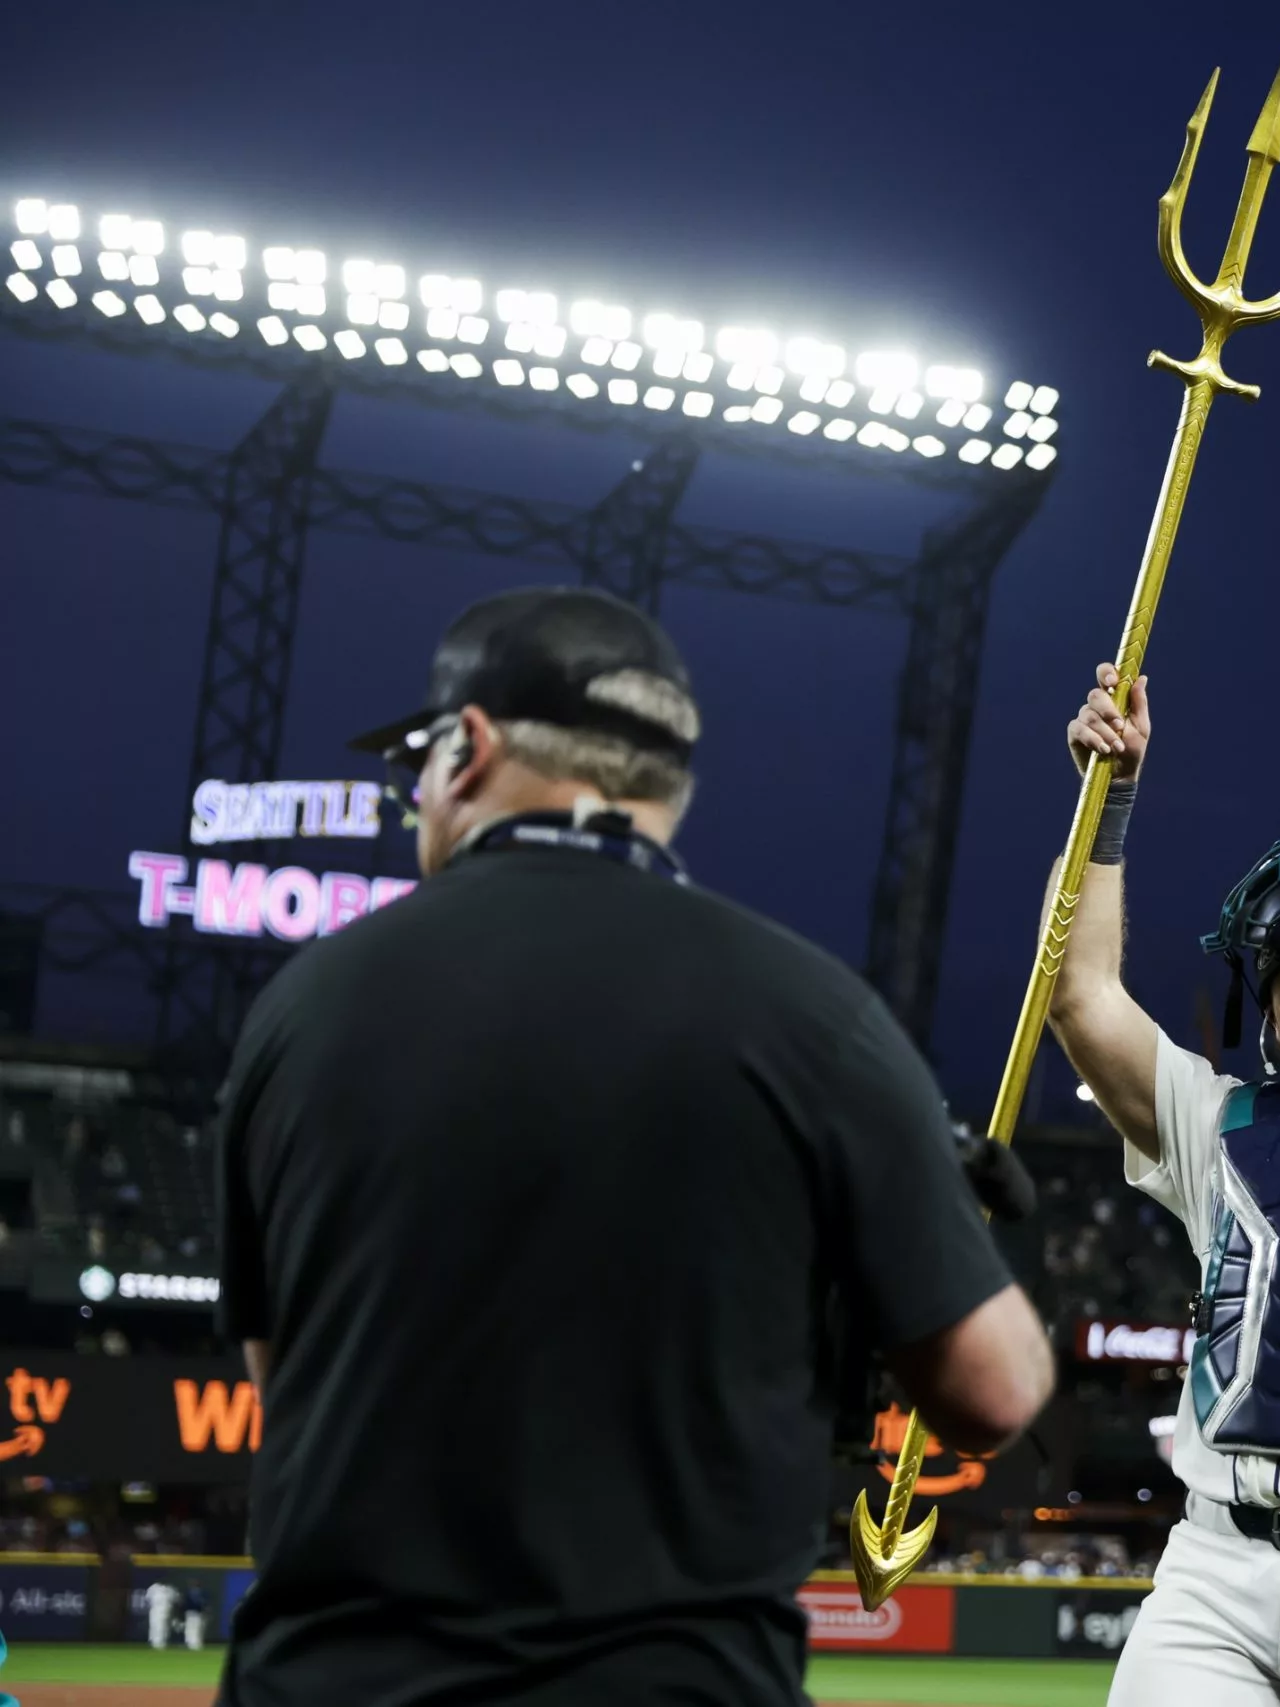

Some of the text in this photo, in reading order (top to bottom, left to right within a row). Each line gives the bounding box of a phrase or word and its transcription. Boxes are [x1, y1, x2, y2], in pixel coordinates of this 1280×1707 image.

[190, 778, 382, 845] SEATTLE
[129, 851, 418, 941] T-MOB
[6, 1367, 71, 1424] tv
